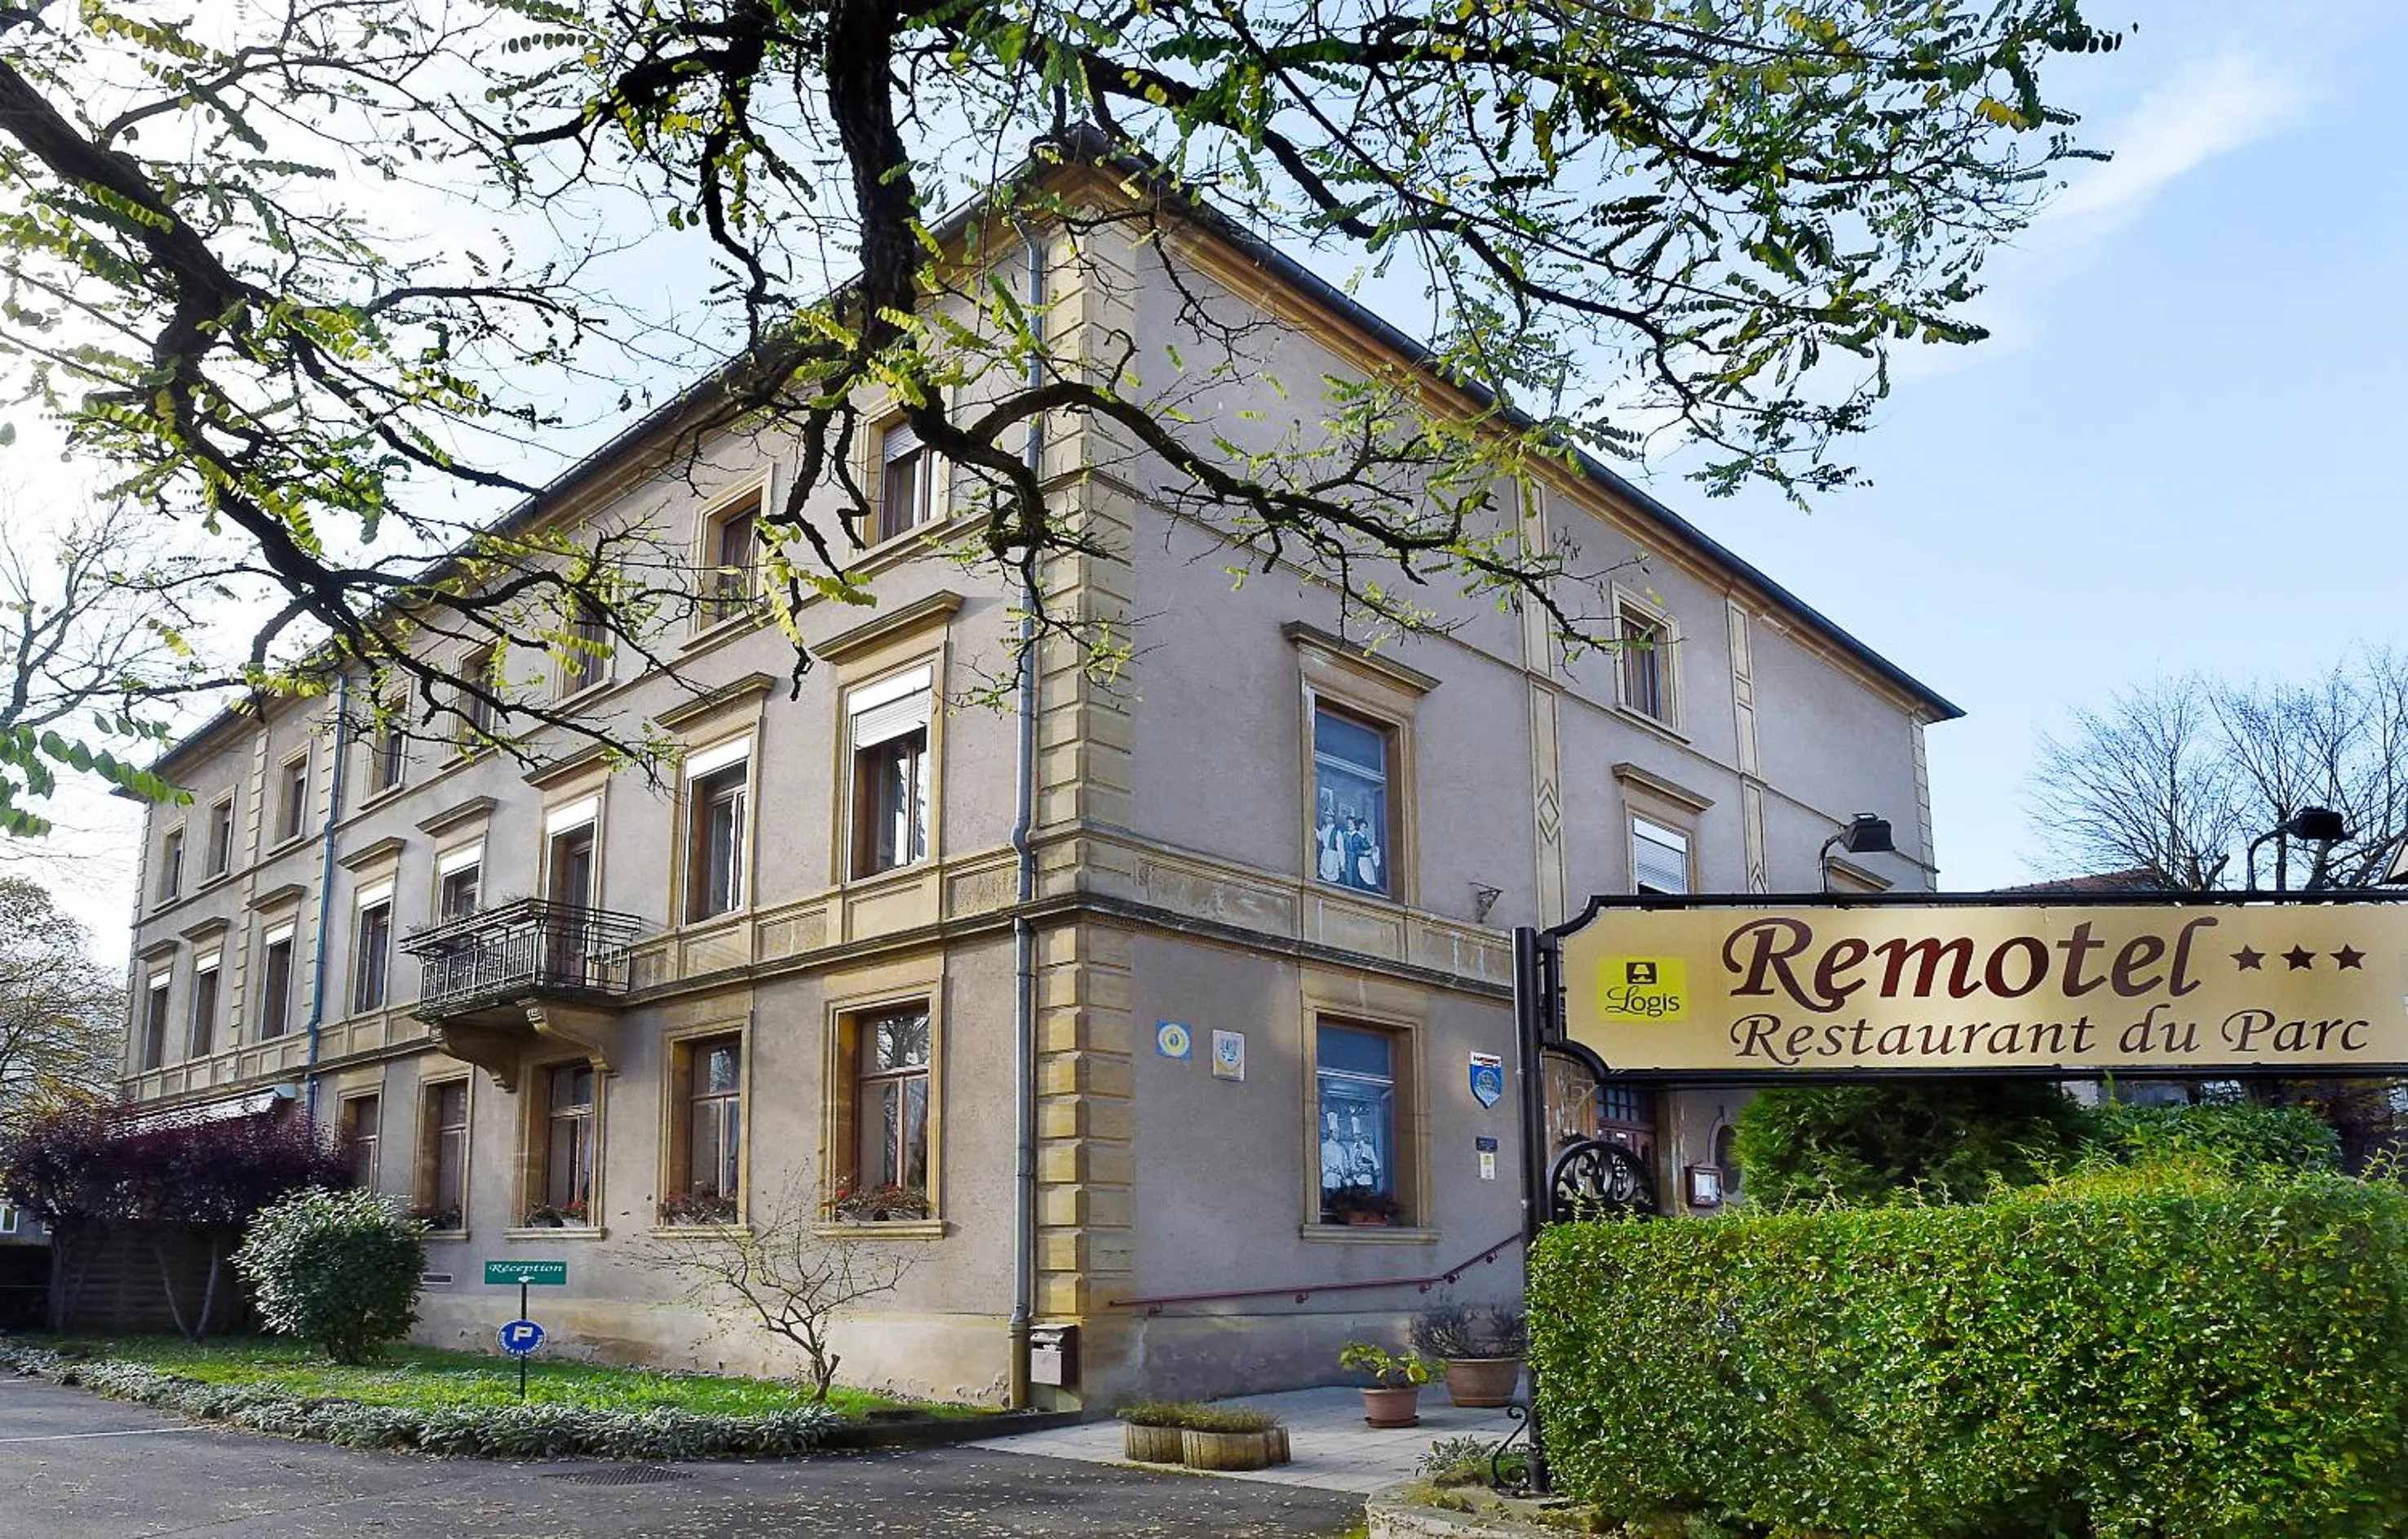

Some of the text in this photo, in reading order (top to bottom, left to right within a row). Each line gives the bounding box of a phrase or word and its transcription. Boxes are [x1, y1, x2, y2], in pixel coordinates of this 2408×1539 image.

[1722, 917, 2220, 1014] Remotel
[1605, 984, 1680, 1018] Logis
[1729, 1002, 2370, 1065] Restaurant du Parc
[513, 1326, 533, 1341] P
